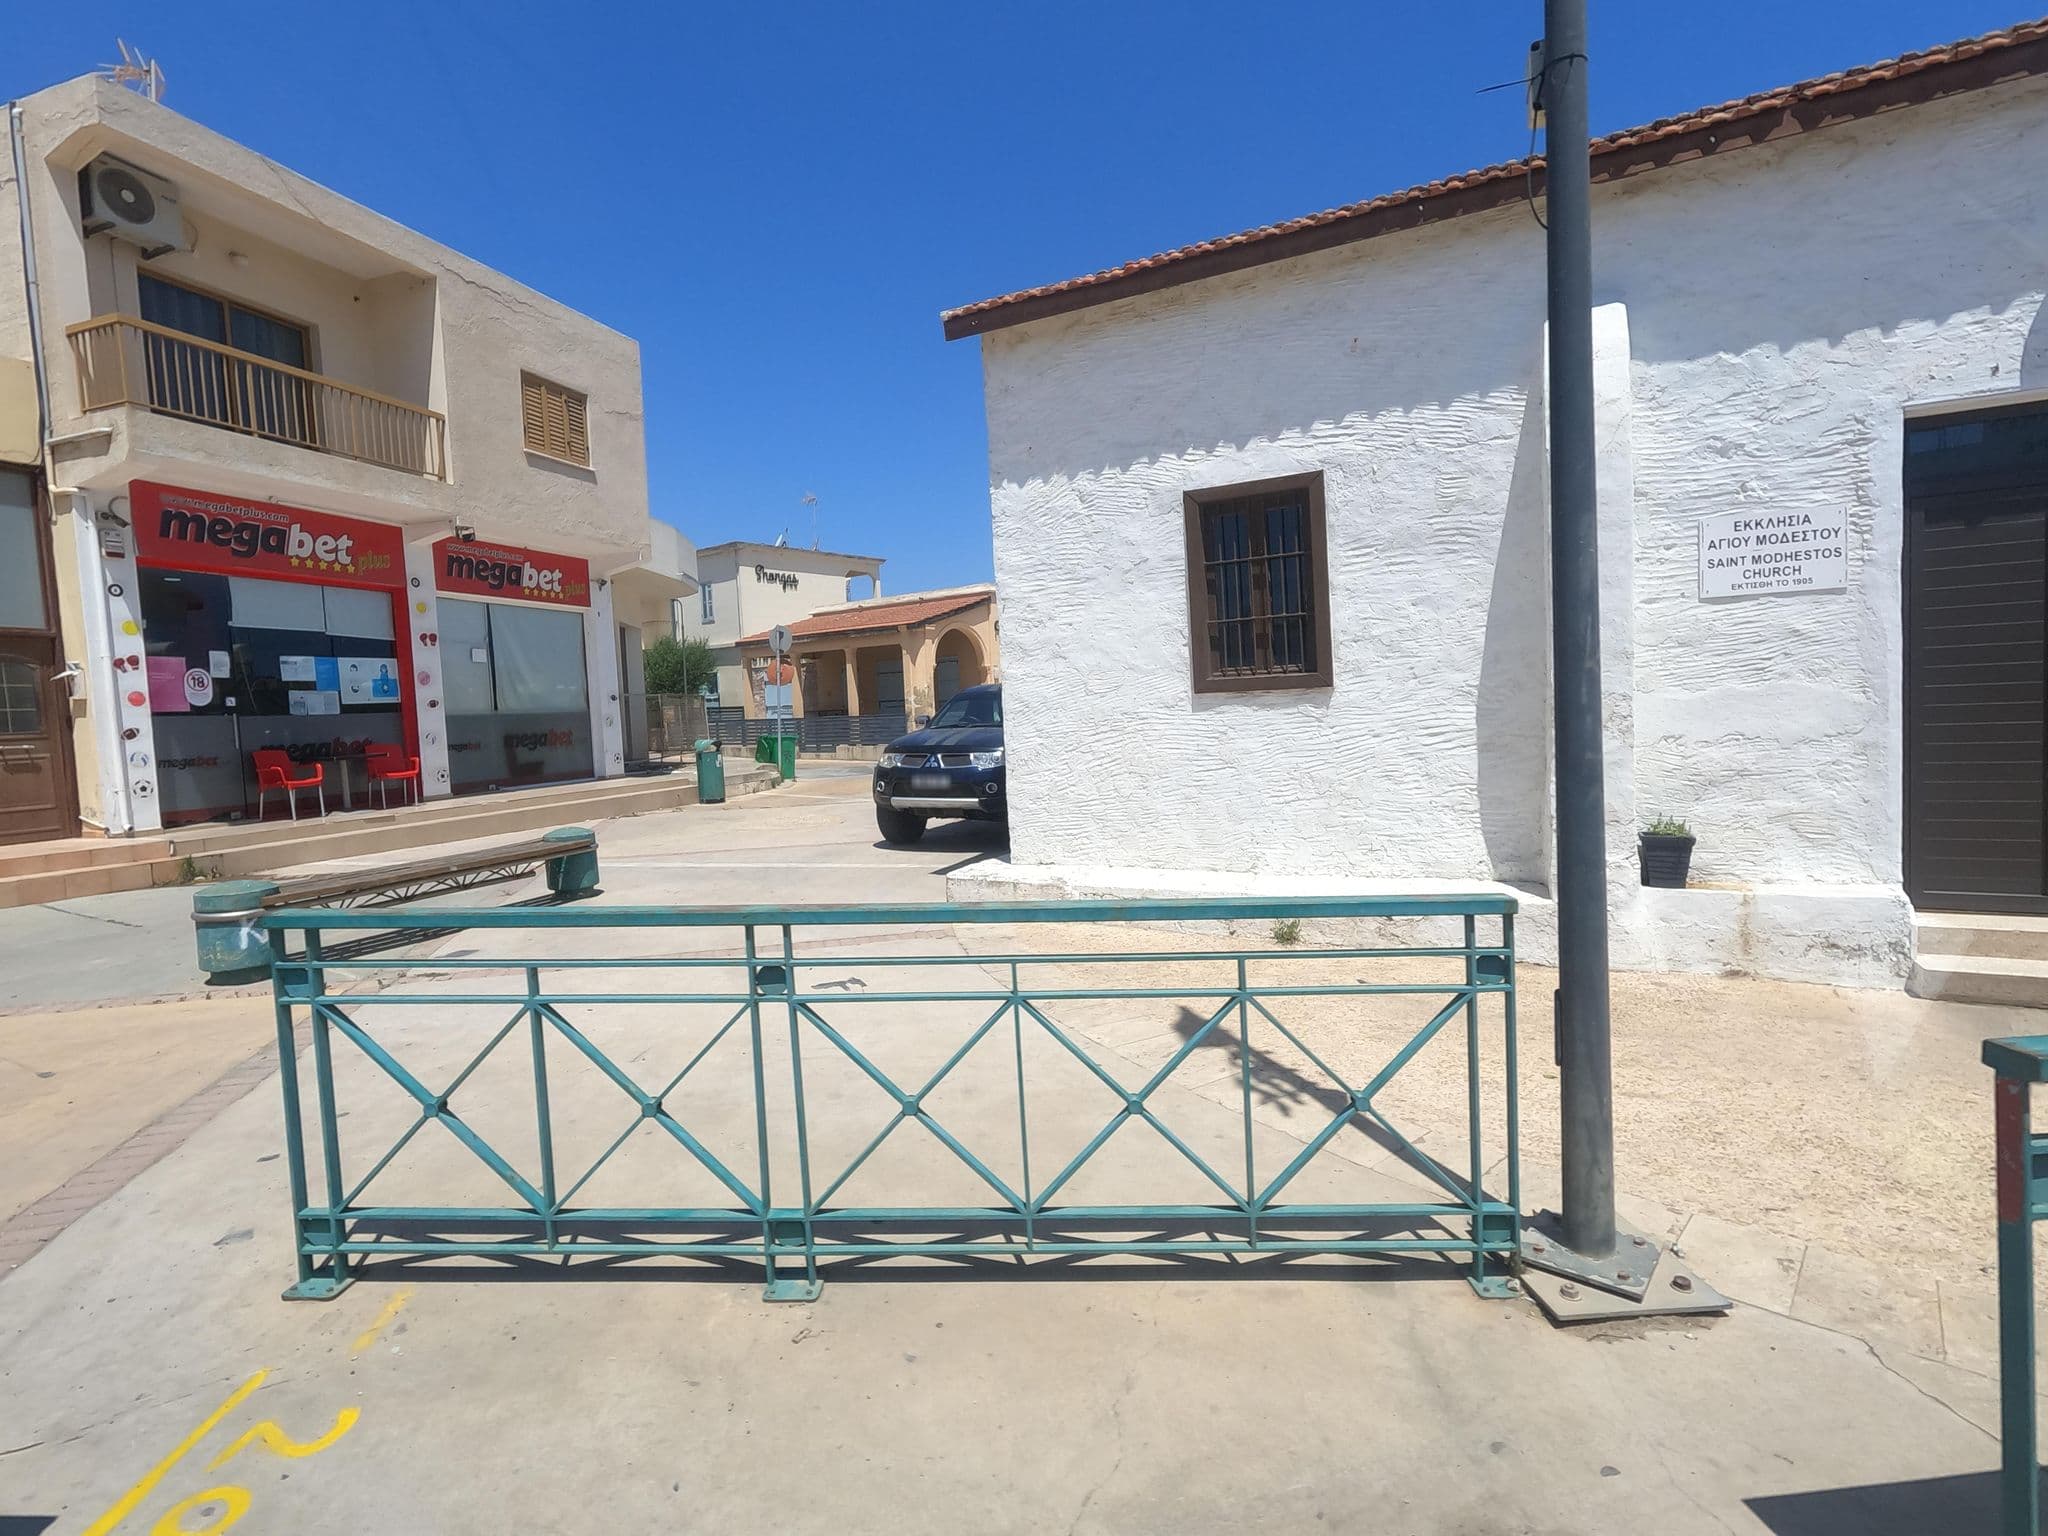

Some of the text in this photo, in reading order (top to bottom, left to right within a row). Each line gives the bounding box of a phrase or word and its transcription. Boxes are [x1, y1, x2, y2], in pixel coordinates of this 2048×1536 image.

[1734, 514, 1812, 532] ΕΚΚΛΗΣΙΑ
[159, 507, 391, 576] megabet plus
[1707, 527, 1842, 551] ΑΓΙΟΥ ΜΟΔΕΣΤΟΥ
[1707, 547, 1843, 570] SAINT MODHESTOS
[447, 554, 563, 593] megabet
[1743, 565, 1801, 580] CHURCH
[1731, 581, 1773, 591] ΕΚΤΙΣΘΗ
[1776, 579, 1790, 587] ΤΟ
[190, 676, 206, 688] 18
[504, 728, 574, 751] megabet
[158, 756, 218, 770] megabet
